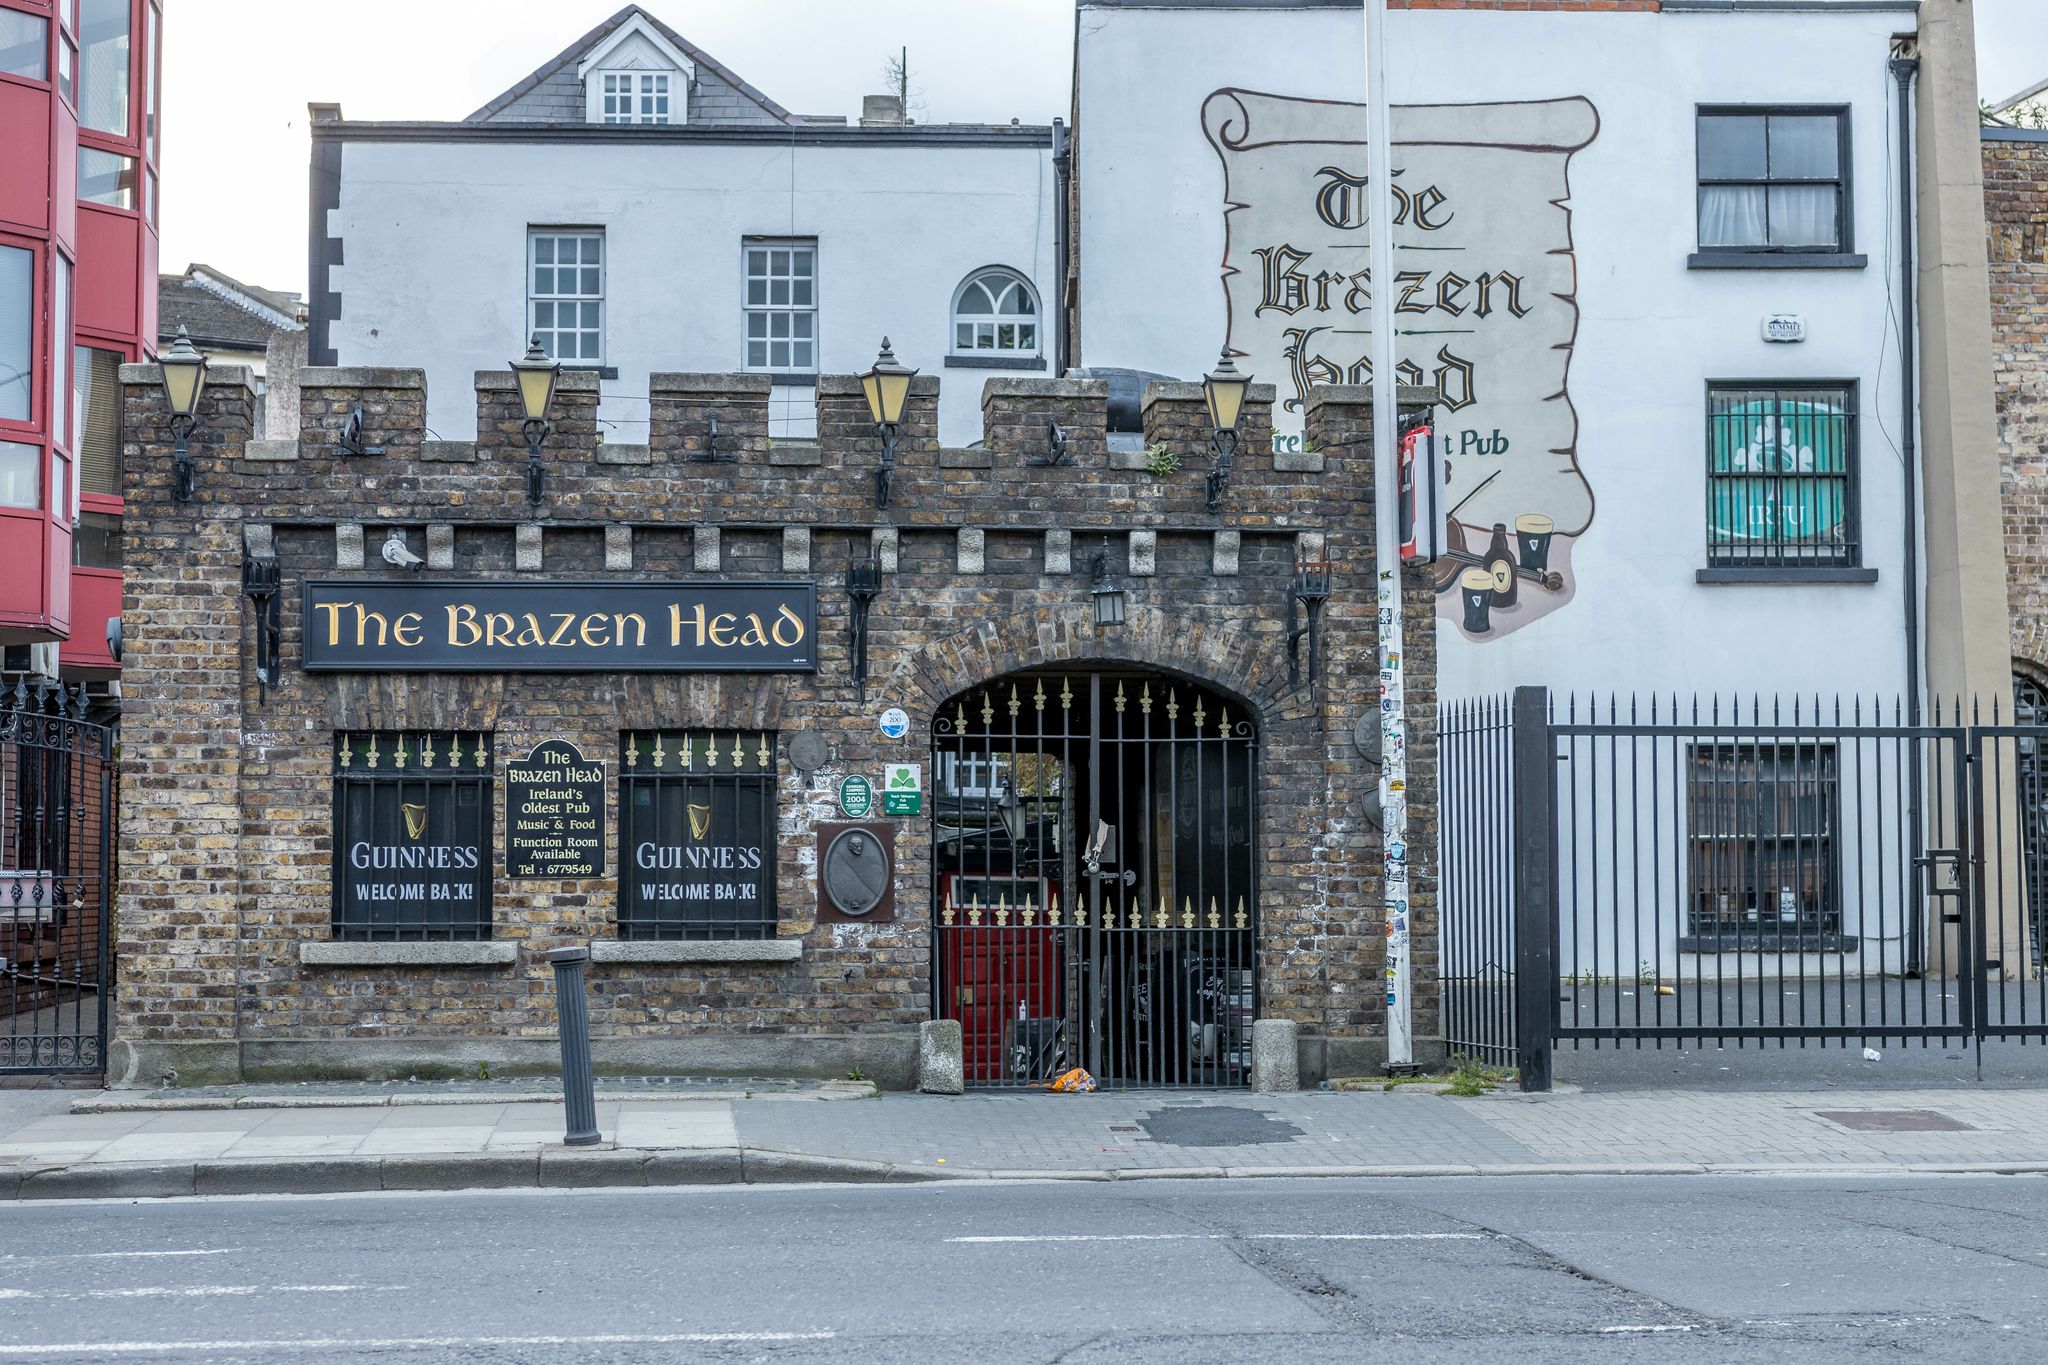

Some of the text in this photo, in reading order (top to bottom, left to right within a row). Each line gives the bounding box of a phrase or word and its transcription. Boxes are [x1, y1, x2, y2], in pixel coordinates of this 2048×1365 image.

[1460, 429, 1509, 455] Pub
[315, 601, 423, 647] The
[669, 602, 805, 648] Head
[543, 751, 570, 764] The
[529, 789, 583, 800] Ireland's
[522, 803, 590, 814] Oldest Pub
[517, 819, 596, 830] Music & Food
[513, 837, 598, 848] Function Room
[351, 842, 478, 869] GUINNESS
[530, 848, 581, 859] Available
[636, 842, 761, 869] GUINNESS
[518, 864, 535, 875] Tel
[547, 864, 592, 874] 6779549
